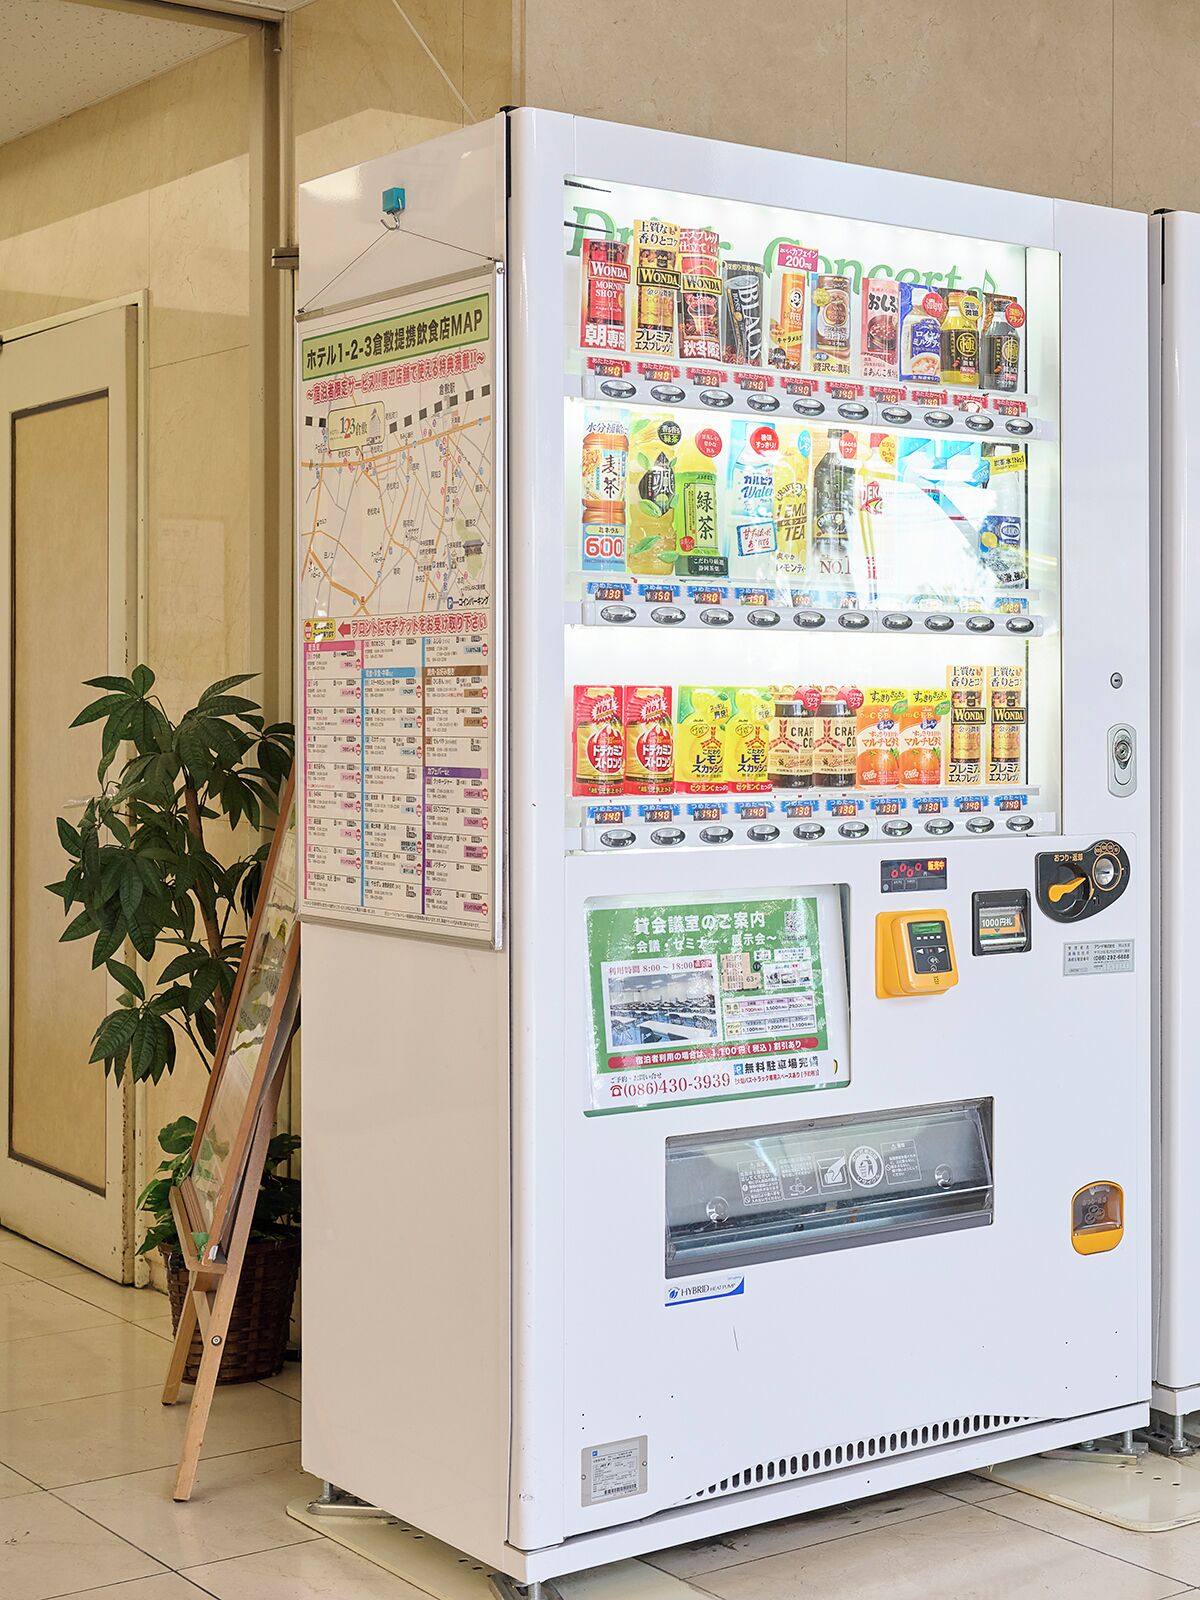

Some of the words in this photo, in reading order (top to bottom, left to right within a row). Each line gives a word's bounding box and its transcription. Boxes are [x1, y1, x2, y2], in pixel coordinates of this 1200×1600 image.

[591, 261, 629, 279] WONDA
[642, 270, 679, 286] WONDA
[686, 275, 720, 291] WONDA
[595, 289, 618, 299] SHOT
[743, 285, 764, 360] BLACK
[307, 308, 483, 370] ホテル1-2-3倉敷提携飲食店MAP
[601, 453, 621, 499] 麦茶
[743, 474, 774, 486] カルピス
[696, 491, 715, 541] 緑茶
[955, 708, 984, 722] WONDA
[995, 708, 1024, 722] WONDA
[790, 726, 814, 737] CRAF
[834, 726, 856, 737] CRAF
[633, 911, 767, 936] 貸会議室のご案内
[981, 917, 1014, 928] 1000円札
[623, 1072, 731, 1098] (086)430-3939
[680, 1284, 710, 1297] HYBRID
